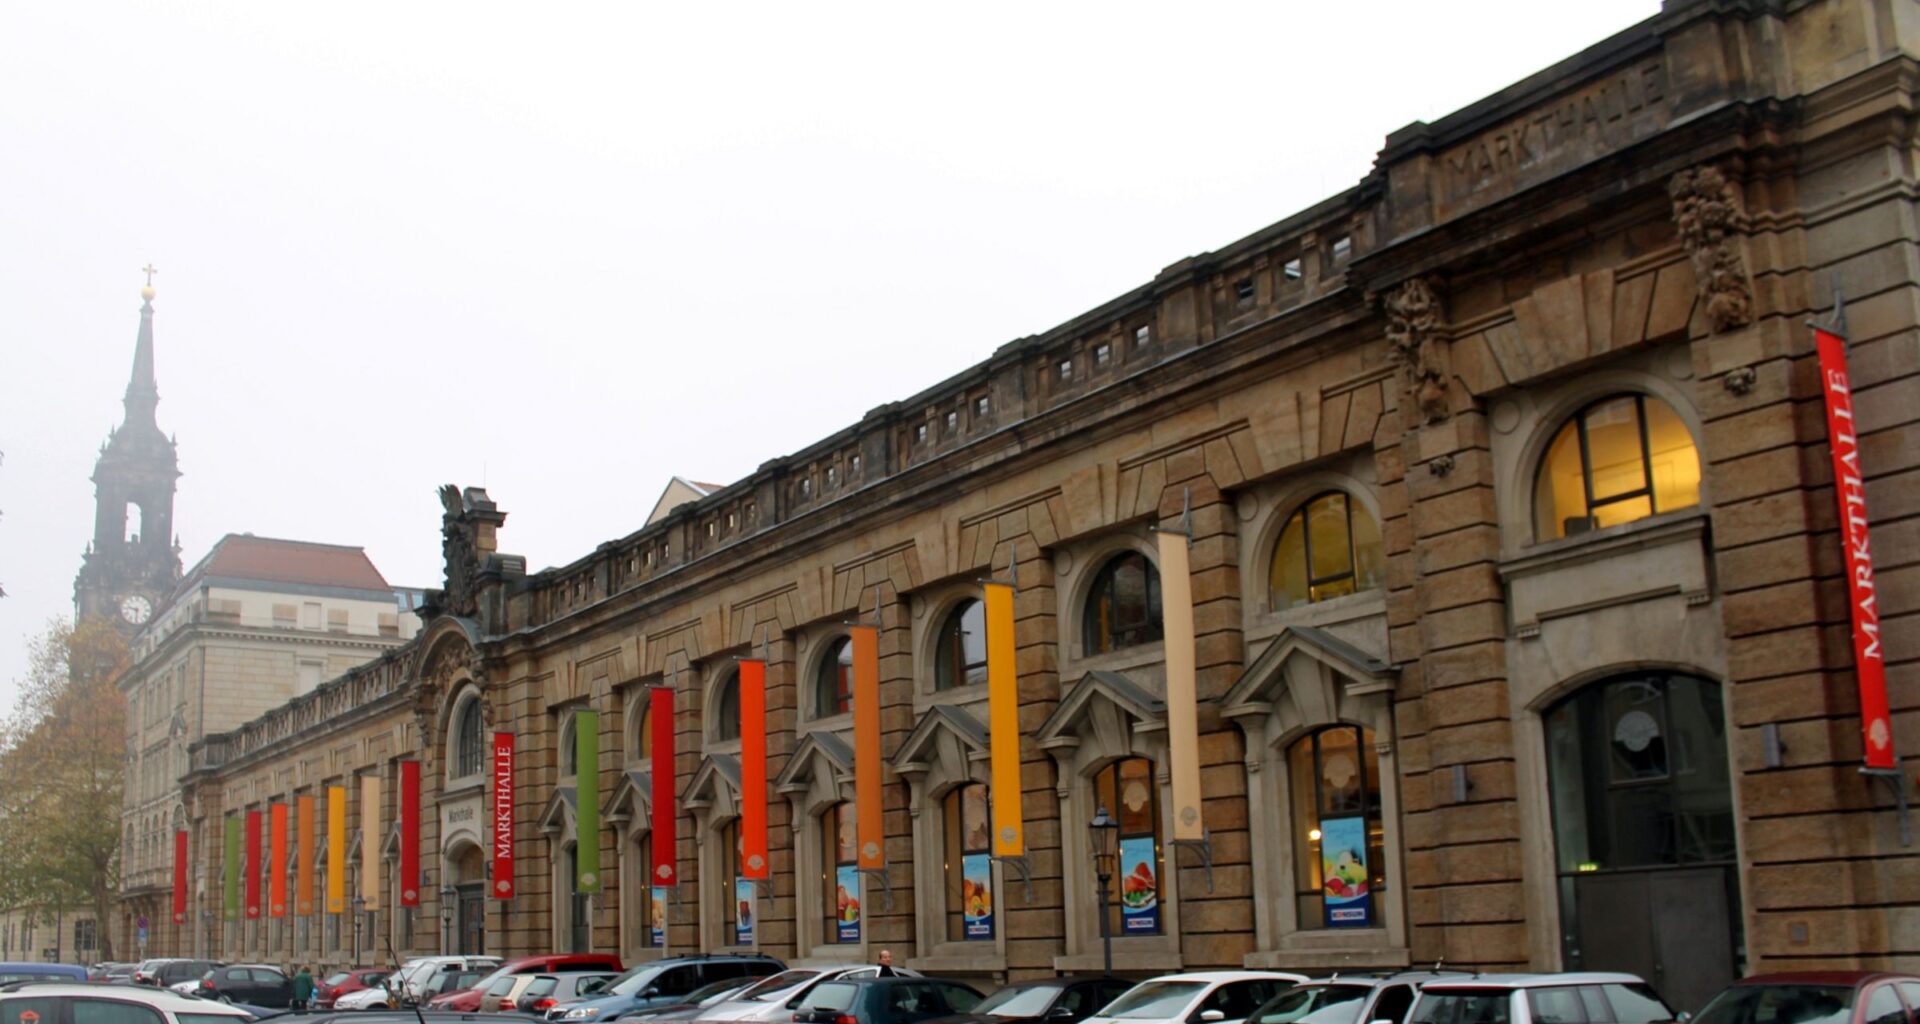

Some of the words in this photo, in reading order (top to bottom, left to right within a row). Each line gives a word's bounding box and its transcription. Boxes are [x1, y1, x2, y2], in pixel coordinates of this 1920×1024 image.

[1446, 64, 1664, 186] MARKTHALLE
[1828, 369, 1881, 659] MARKTHALLE
[448, 806, 473, 823] Markthalle
[497, 747, 511, 858] MARKTHALLE
